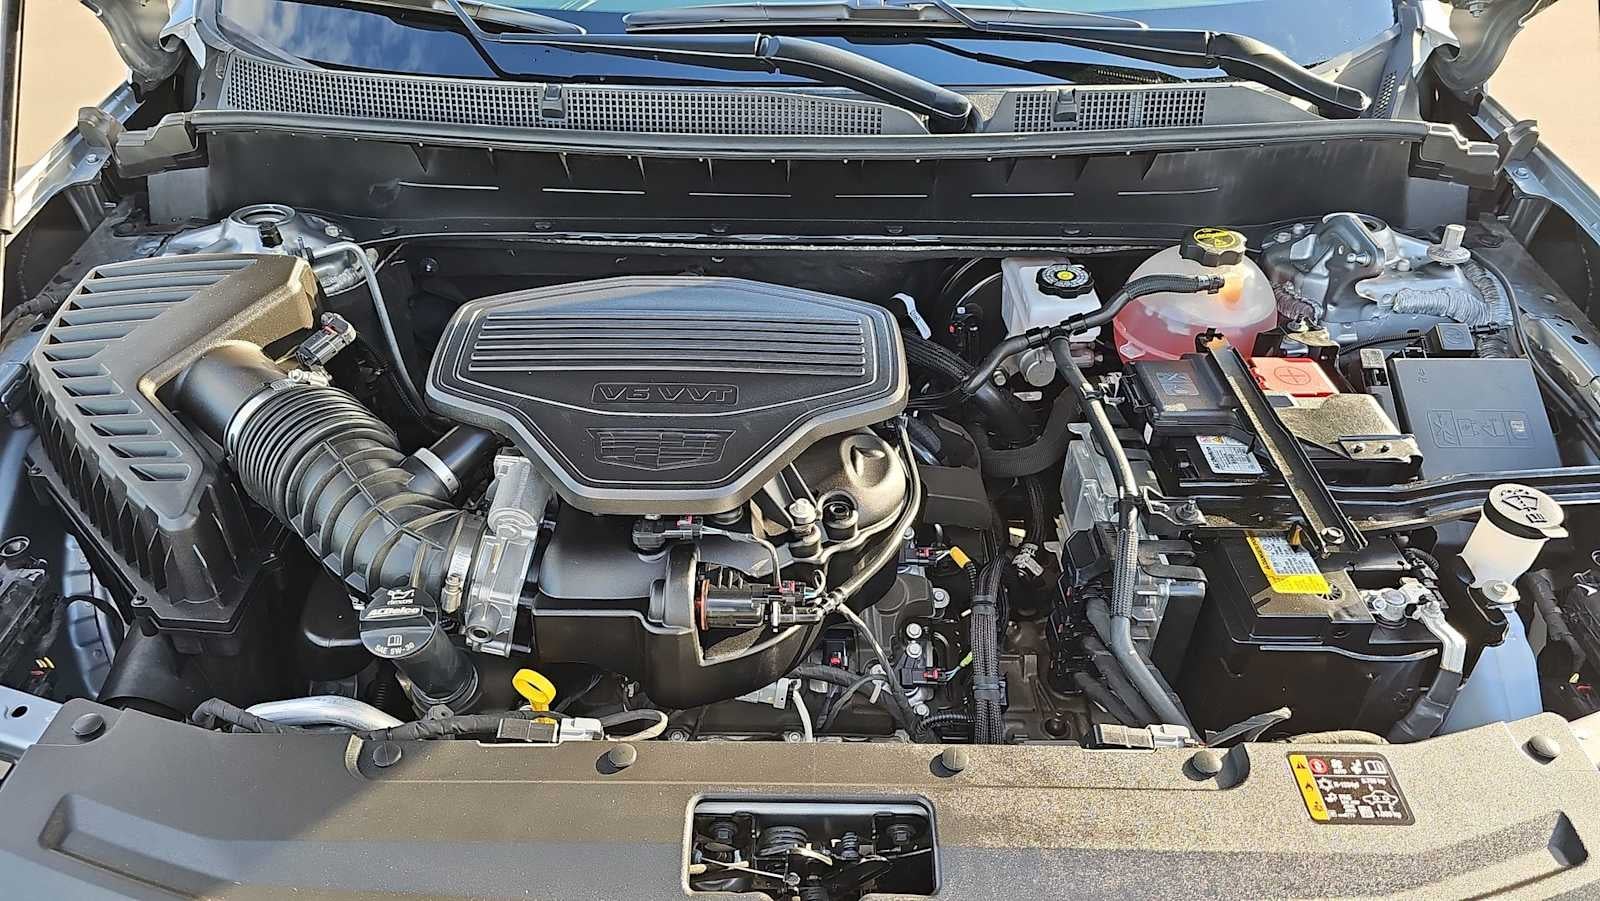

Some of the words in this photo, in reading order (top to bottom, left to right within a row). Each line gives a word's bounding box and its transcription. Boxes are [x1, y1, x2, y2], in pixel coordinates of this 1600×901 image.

[600, 386, 650, 401] V6
[658, 386, 733, 402] VVT
[366, 606, 421, 618] ACDelco
[375, 644, 389, 655] SAE
[390, 641, 416, 655] 5W-30
